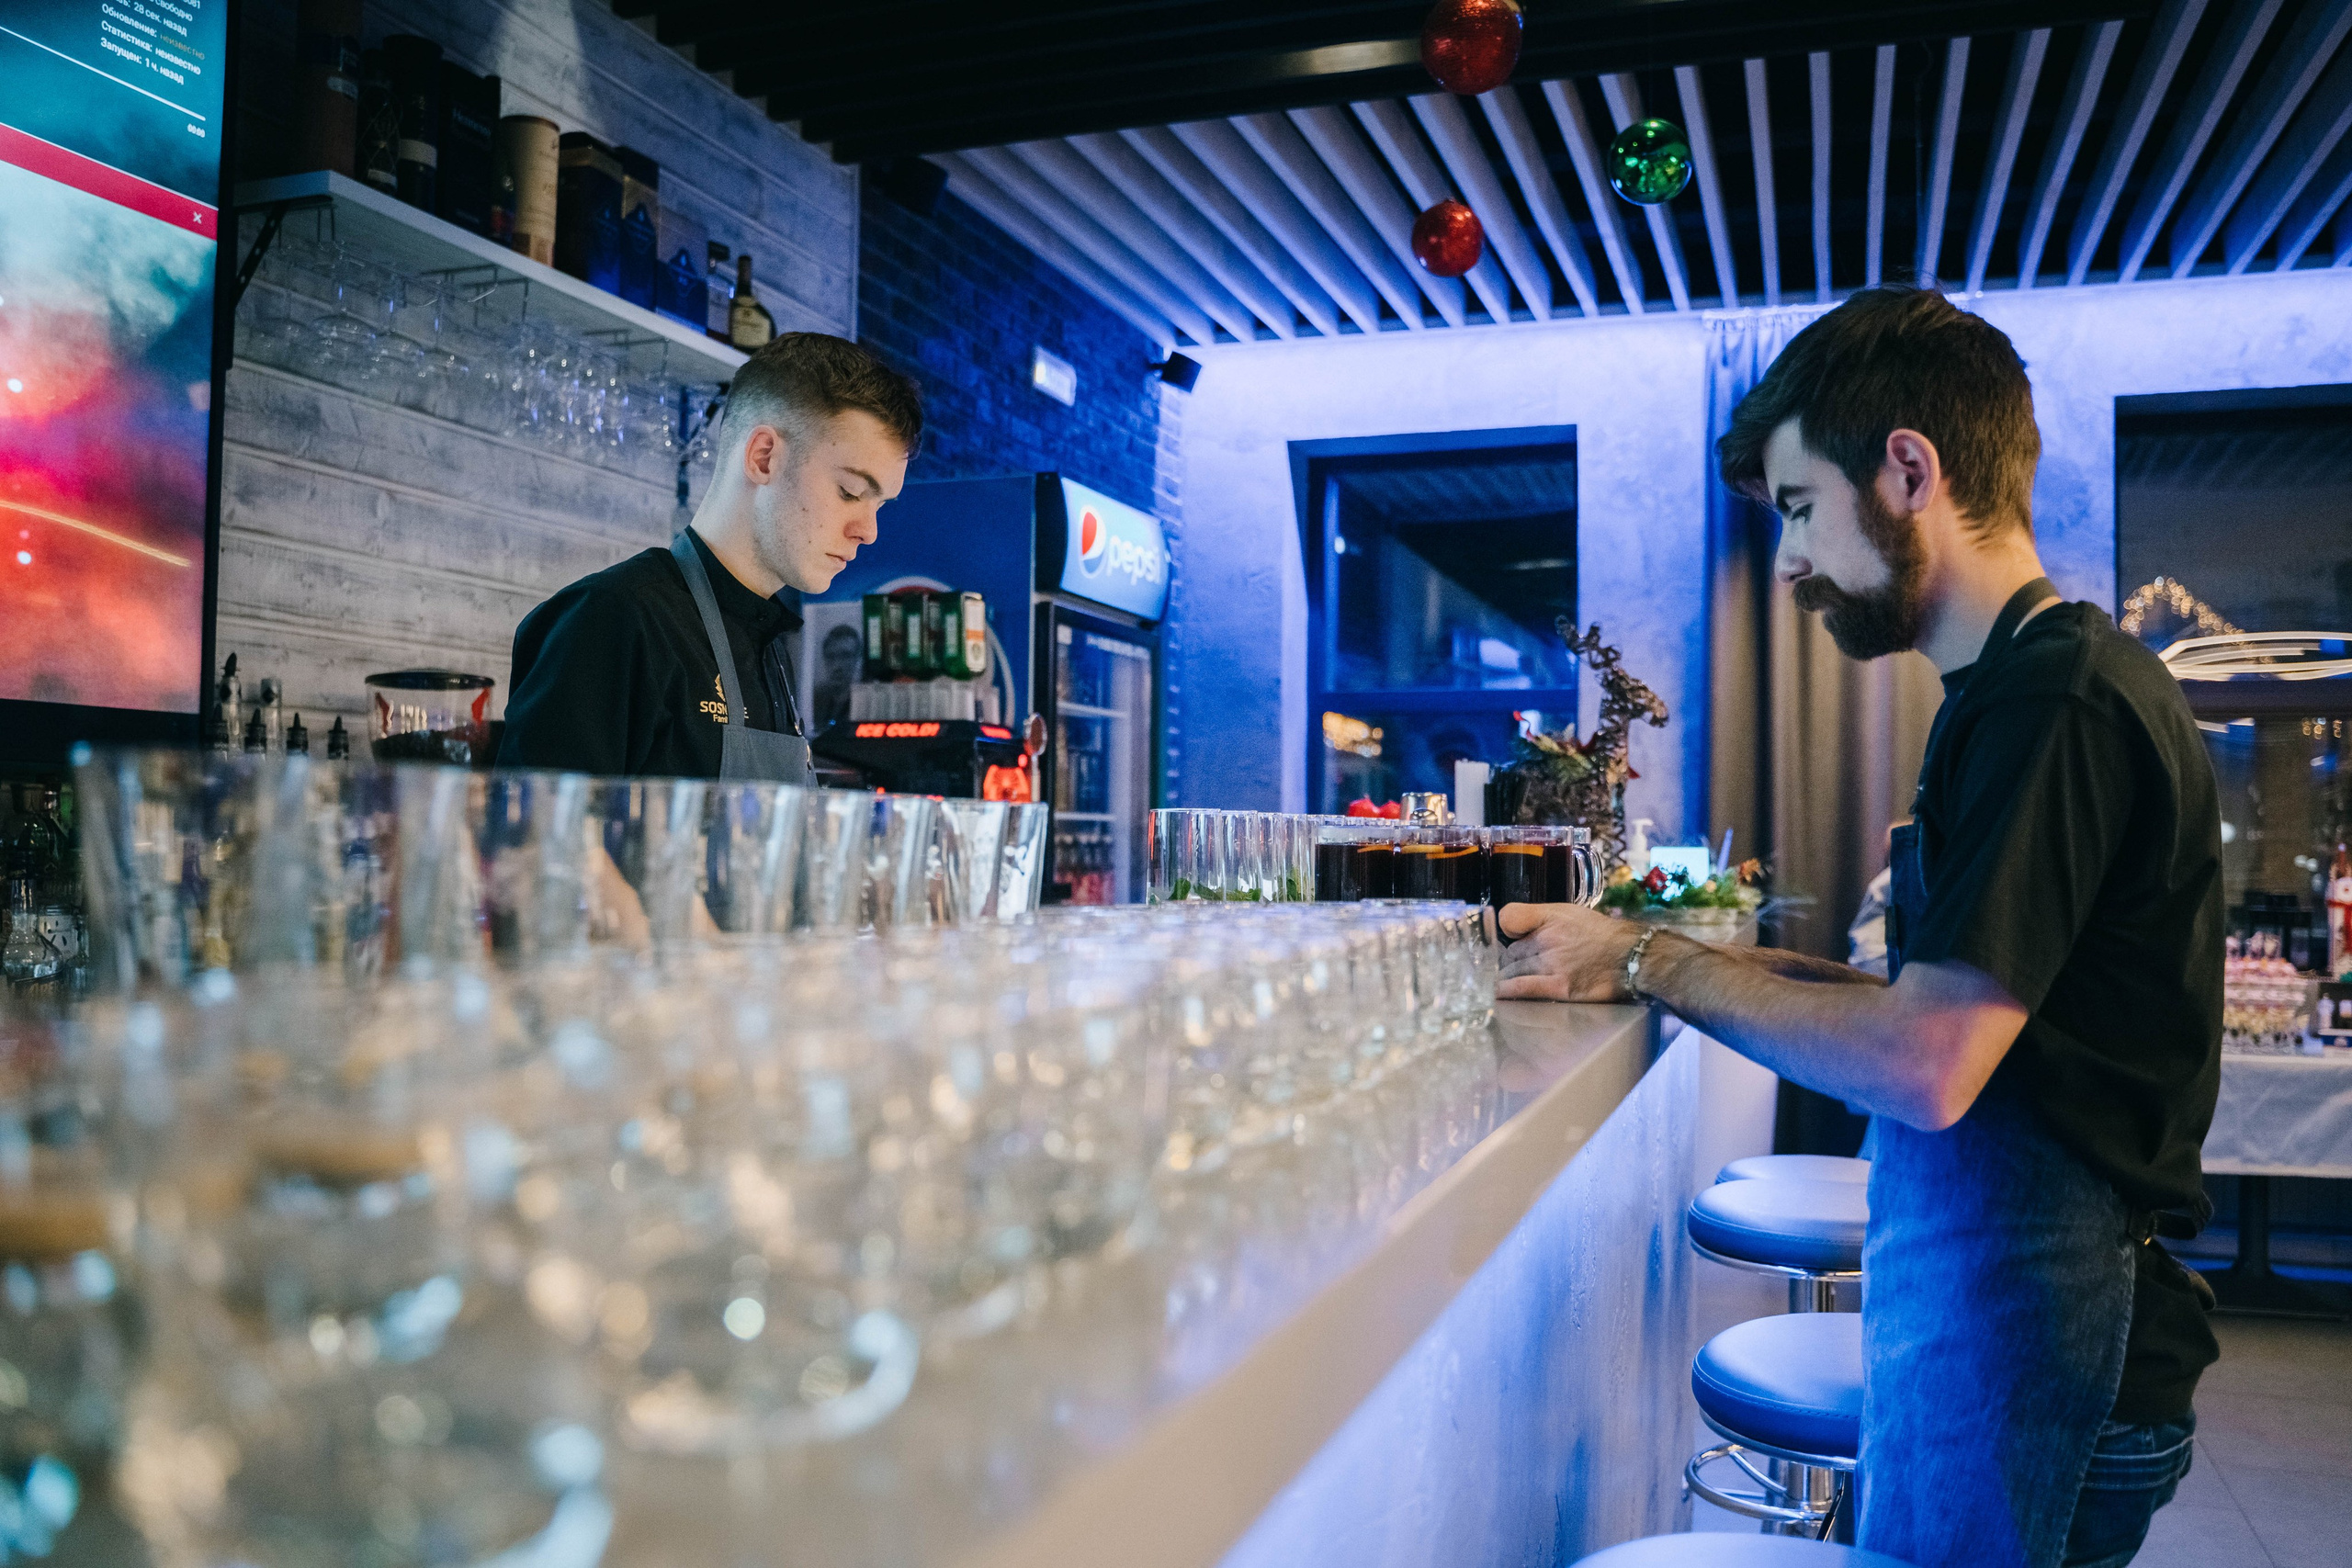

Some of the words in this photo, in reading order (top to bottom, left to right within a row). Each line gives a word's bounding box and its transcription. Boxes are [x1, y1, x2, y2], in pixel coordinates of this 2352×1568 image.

[101, 3, 157, 38] Обновление:
[160, 34, 205, 60] неизвестно
[132, 2, 144, 15] 28
[145, 9, 162, 24] сек.
[164, 17, 187, 37] назад
[100, 37, 142, 64] Запущен:
[145, 57, 150, 68] 1
[151, 62, 159, 73] ч.
[160, 66, 184, 85] назад
[101, 20, 153, 52] Статистика:
[155, 47, 201, 75] неизвестно
[1107, 535, 1160, 586] pepsi
[855, 723, 887, 738] ICE
[886, 722, 940, 738] COLD!
